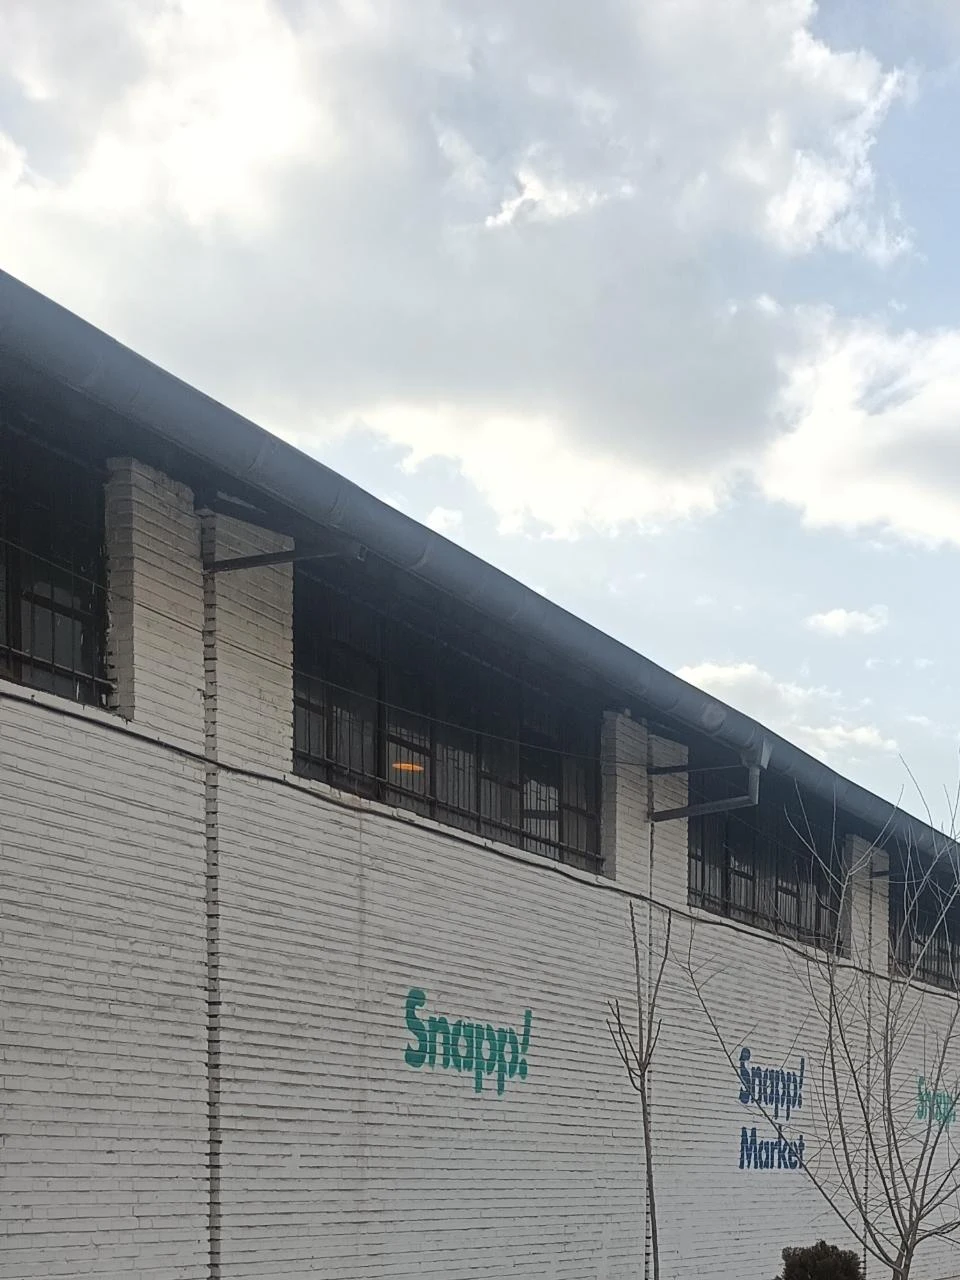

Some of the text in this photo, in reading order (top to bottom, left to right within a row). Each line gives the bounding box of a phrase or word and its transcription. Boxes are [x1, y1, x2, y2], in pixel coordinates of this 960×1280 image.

[405, 988, 532, 1096] Snapp!
[739, 1047, 805, 1121] Snapp!
[739, 1125, 805, 1170] Market
